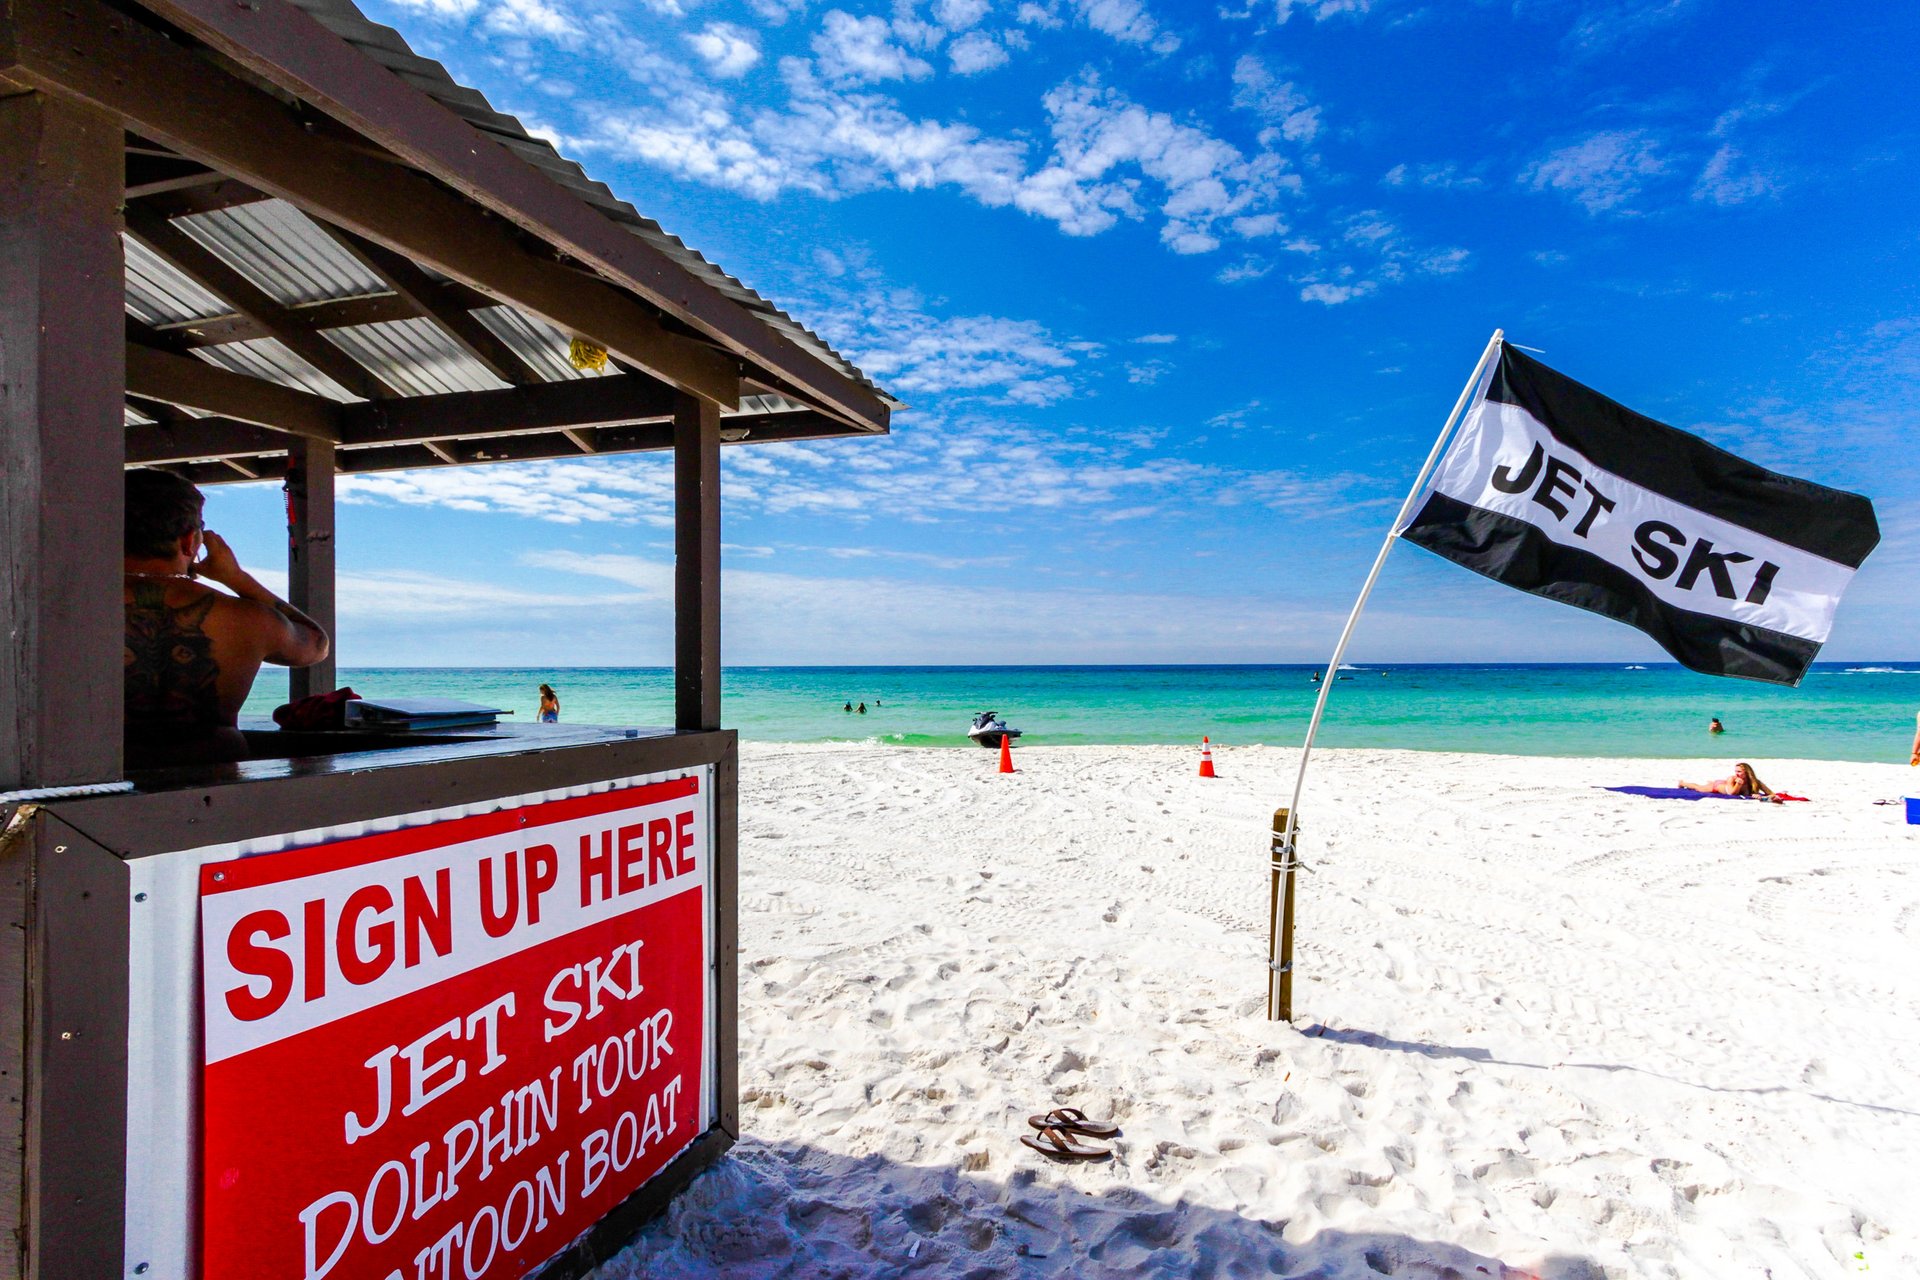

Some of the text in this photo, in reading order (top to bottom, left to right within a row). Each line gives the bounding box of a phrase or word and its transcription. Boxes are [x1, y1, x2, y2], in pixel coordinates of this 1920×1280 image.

[1491, 440, 1781, 606] JET SKI
[224, 810, 697, 1022] SIGN UP HERE
[299, 1008, 675, 1280] DOLPHIN TOUR
[344, 939, 644, 1145] JET SKI
[580, 1074, 683, 1199] BOAT
